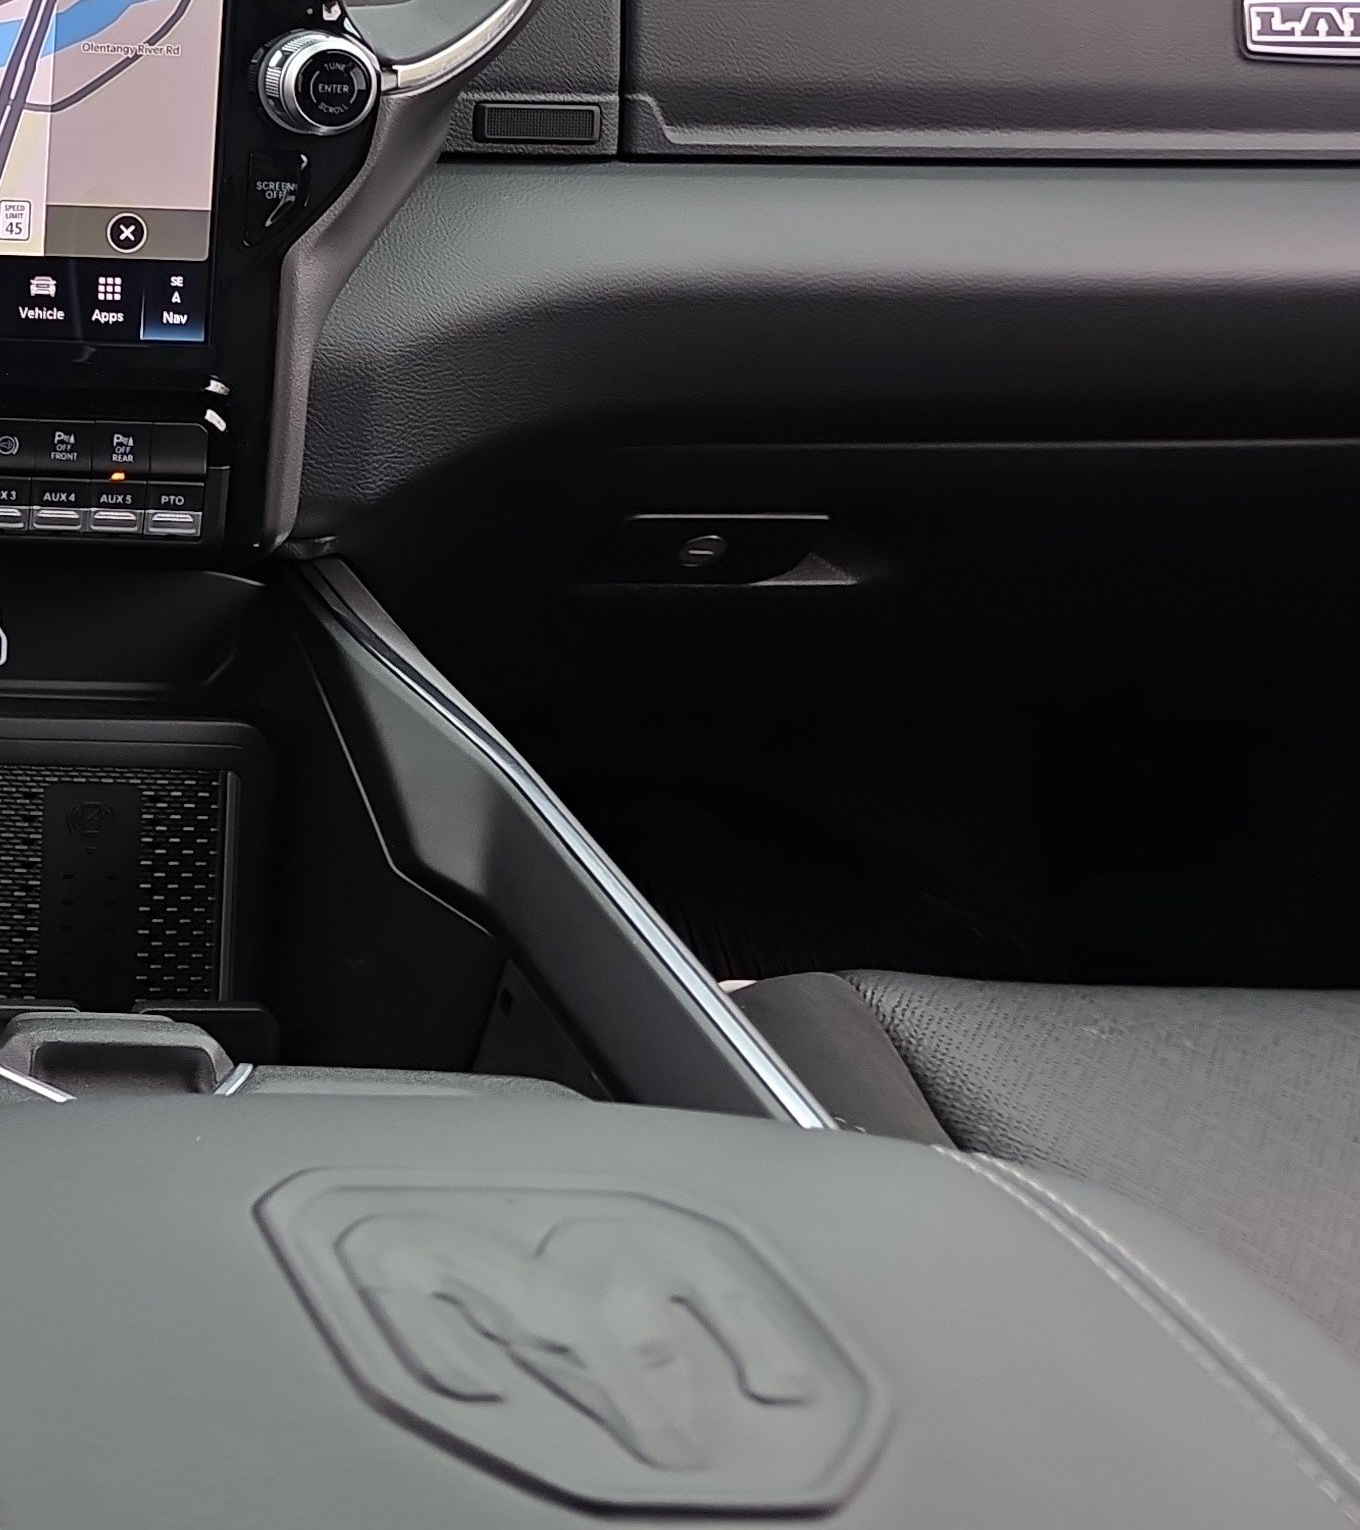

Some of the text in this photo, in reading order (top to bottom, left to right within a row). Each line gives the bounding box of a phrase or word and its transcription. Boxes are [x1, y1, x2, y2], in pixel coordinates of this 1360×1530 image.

[81, 42, 180, 55] Olentangy River Rd
[318, 83, 349, 95] ENTER
[318, 102, 349, 114] SCROLL
[256, 180, 296, 191] SCREEN
[3, 204, 26, 213] SPEED
[4, 212, 24, 221] LIMIT
[5, 222, 23, 235] 45
[18, 307, 65, 320] Vehicle
[92, 309, 124, 325] Apps
[162, 311, 188, 325] Nav
[56, 443, 72, 452] OFF
[115, 446, 131, 454] OFF
[51, 451, 77, 461] FRONT
[112, 453, 134, 463] REAR
[9, 490, 17, 500] 3
[43, 492, 75, 502] AUX 4
[100, 494, 132, 504] AUX 5
[161, 495, 185, 505] PTO
